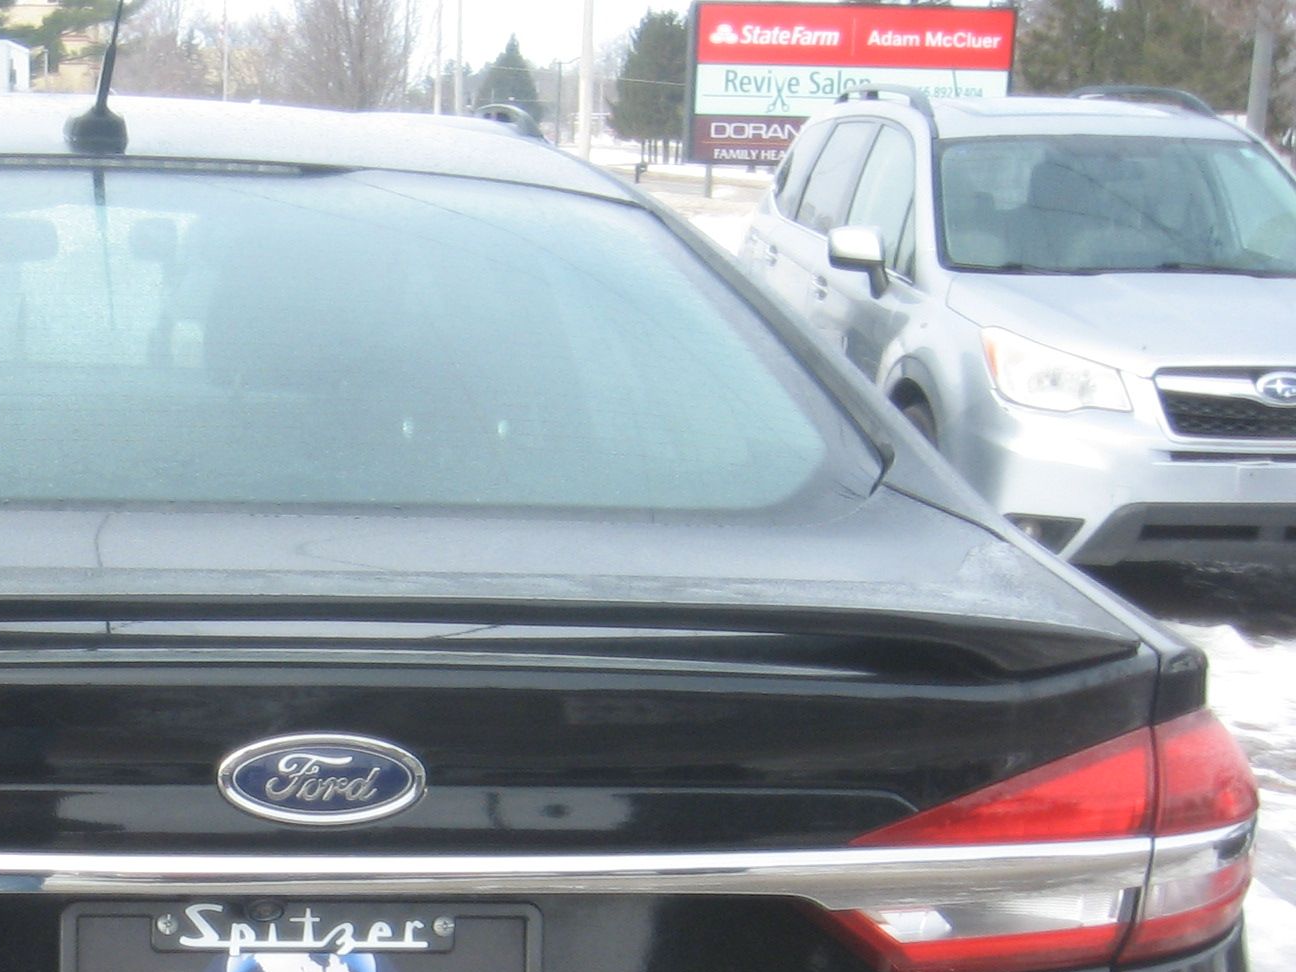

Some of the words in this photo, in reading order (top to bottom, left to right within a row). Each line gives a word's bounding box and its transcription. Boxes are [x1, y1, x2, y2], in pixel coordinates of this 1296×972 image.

[867, 29, 920, 47] Adam
[925, 31, 1001, 49] McCluer
[724, 69, 800, 95] Revive
[713, 148, 758, 160] FAMILY
[265, 753, 381, 802] Ford
[179, 903, 428, 956] Spitzer
